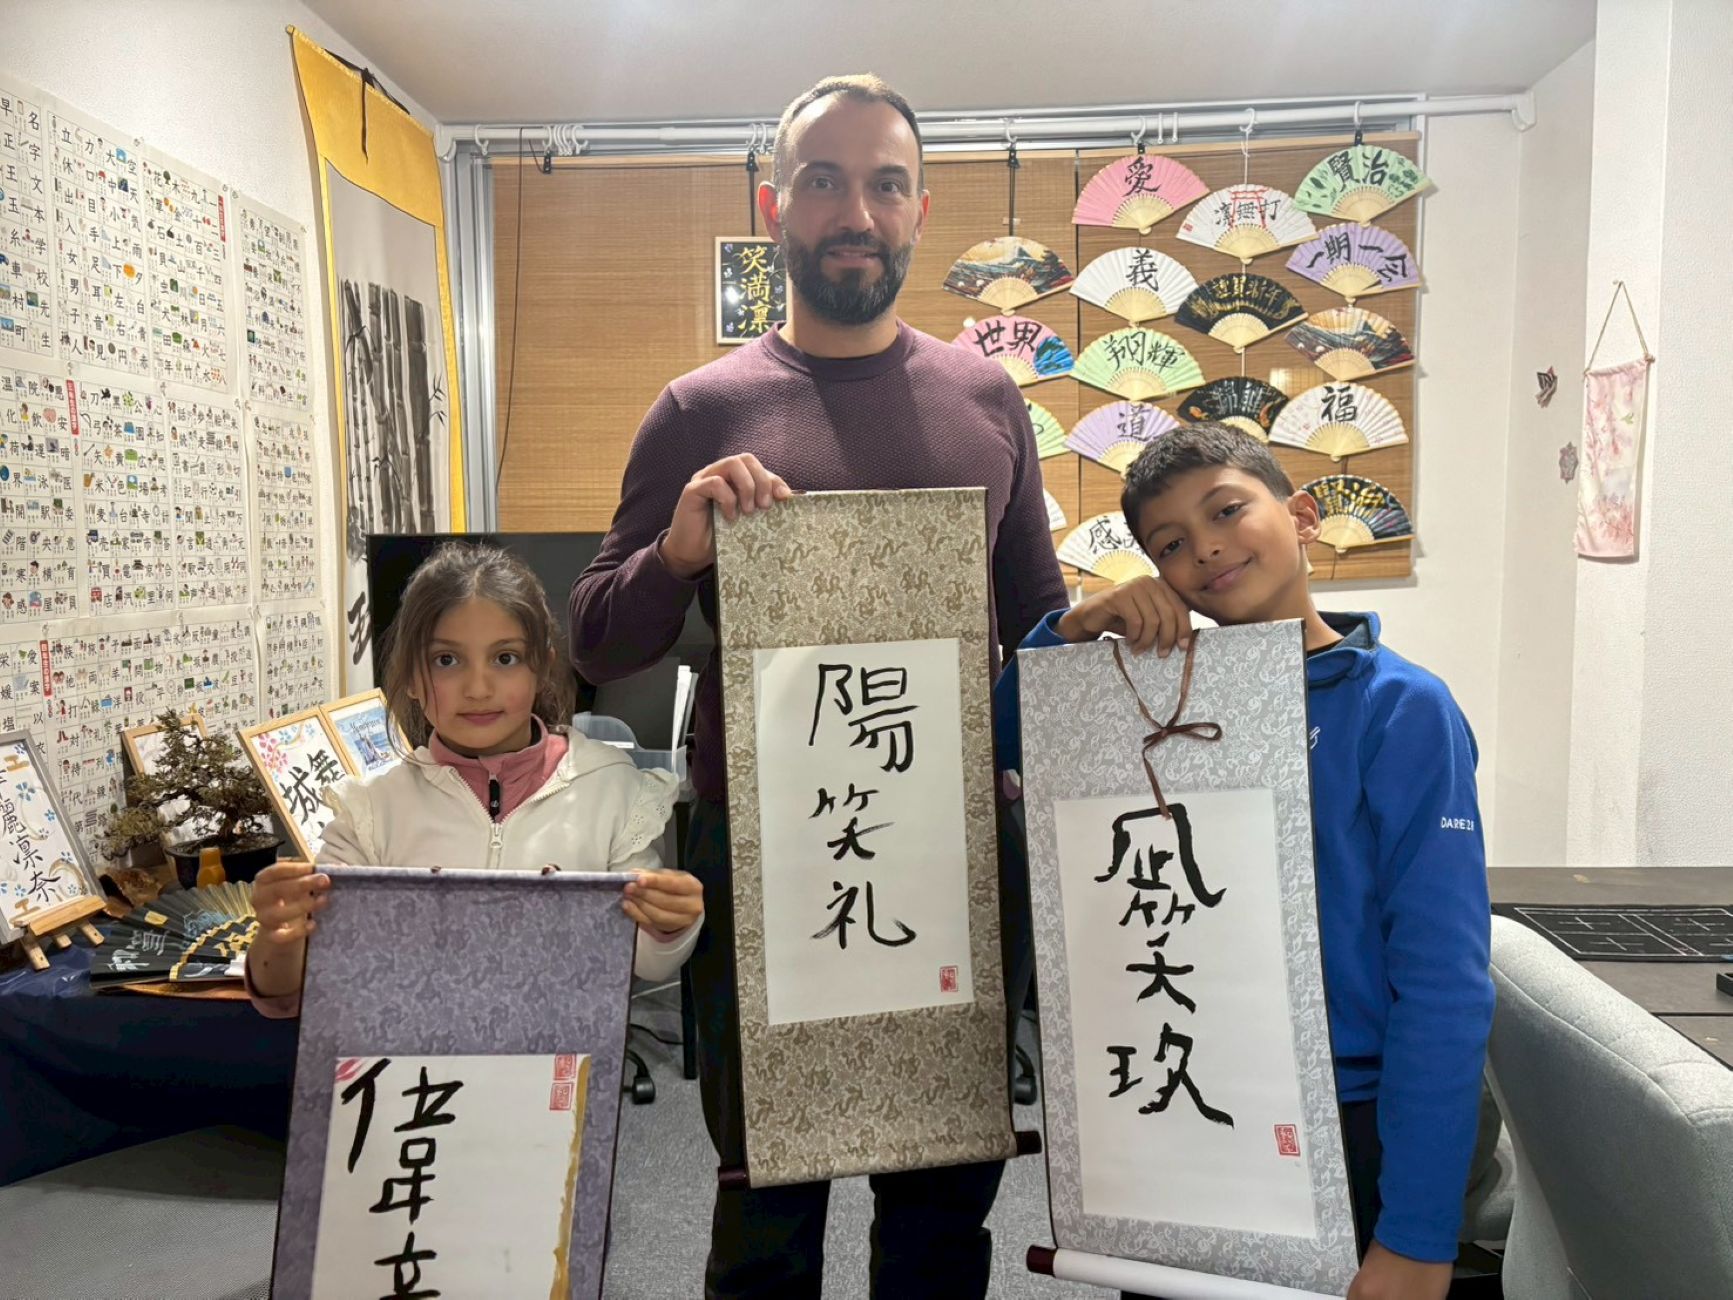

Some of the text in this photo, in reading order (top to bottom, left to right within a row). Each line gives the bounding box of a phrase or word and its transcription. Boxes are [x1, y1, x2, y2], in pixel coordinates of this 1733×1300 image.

[28, 112, 39, 130] 名
[4, 132, 15, 150] 正
[62, 128, 72, 144] 立
[29, 144, 40, 161] 字
[85, 139, 94, 154] 力
[63, 157, 73, 174] 休
[106, 150, 115, 166] 大
[6, 164, 17, 182] 王
[1123, 156, 1160, 197] 愛
[1327, 149, 1389, 192] 賢治
[31, 176, 42, 194] 文
[65, 188, 73, 204] 出
[34, 206, 45, 222] 本
[10, 229, 20, 247] 糸
[89, 227, 99, 242] 手
[112, 236, 121, 250] 上
[36, 238, 46, 255] 学
[67, 249, 77, 265] 女
[1306, 231, 1408, 282] 一期一会
[37, 269, 49, 287] 校
[1125, 248, 1159, 292] 義
[13, 293, 23, 310] 村
[70, 308, 80, 324] 子
[16, 325, 26, 341] 町
[42, 332, 51, 348] 生
[973, 319, 1042, 358] 世界
[72, 339, 82, 355] 人
[1102, 331, 1186, 374] 翔輝
[1321, 385, 1357, 422] 福
[1117, 403, 1150, 442] 道
[808, 663, 919, 950] 陽笑礼
[1093, 802, 1235, 1129] 凪笑玖
